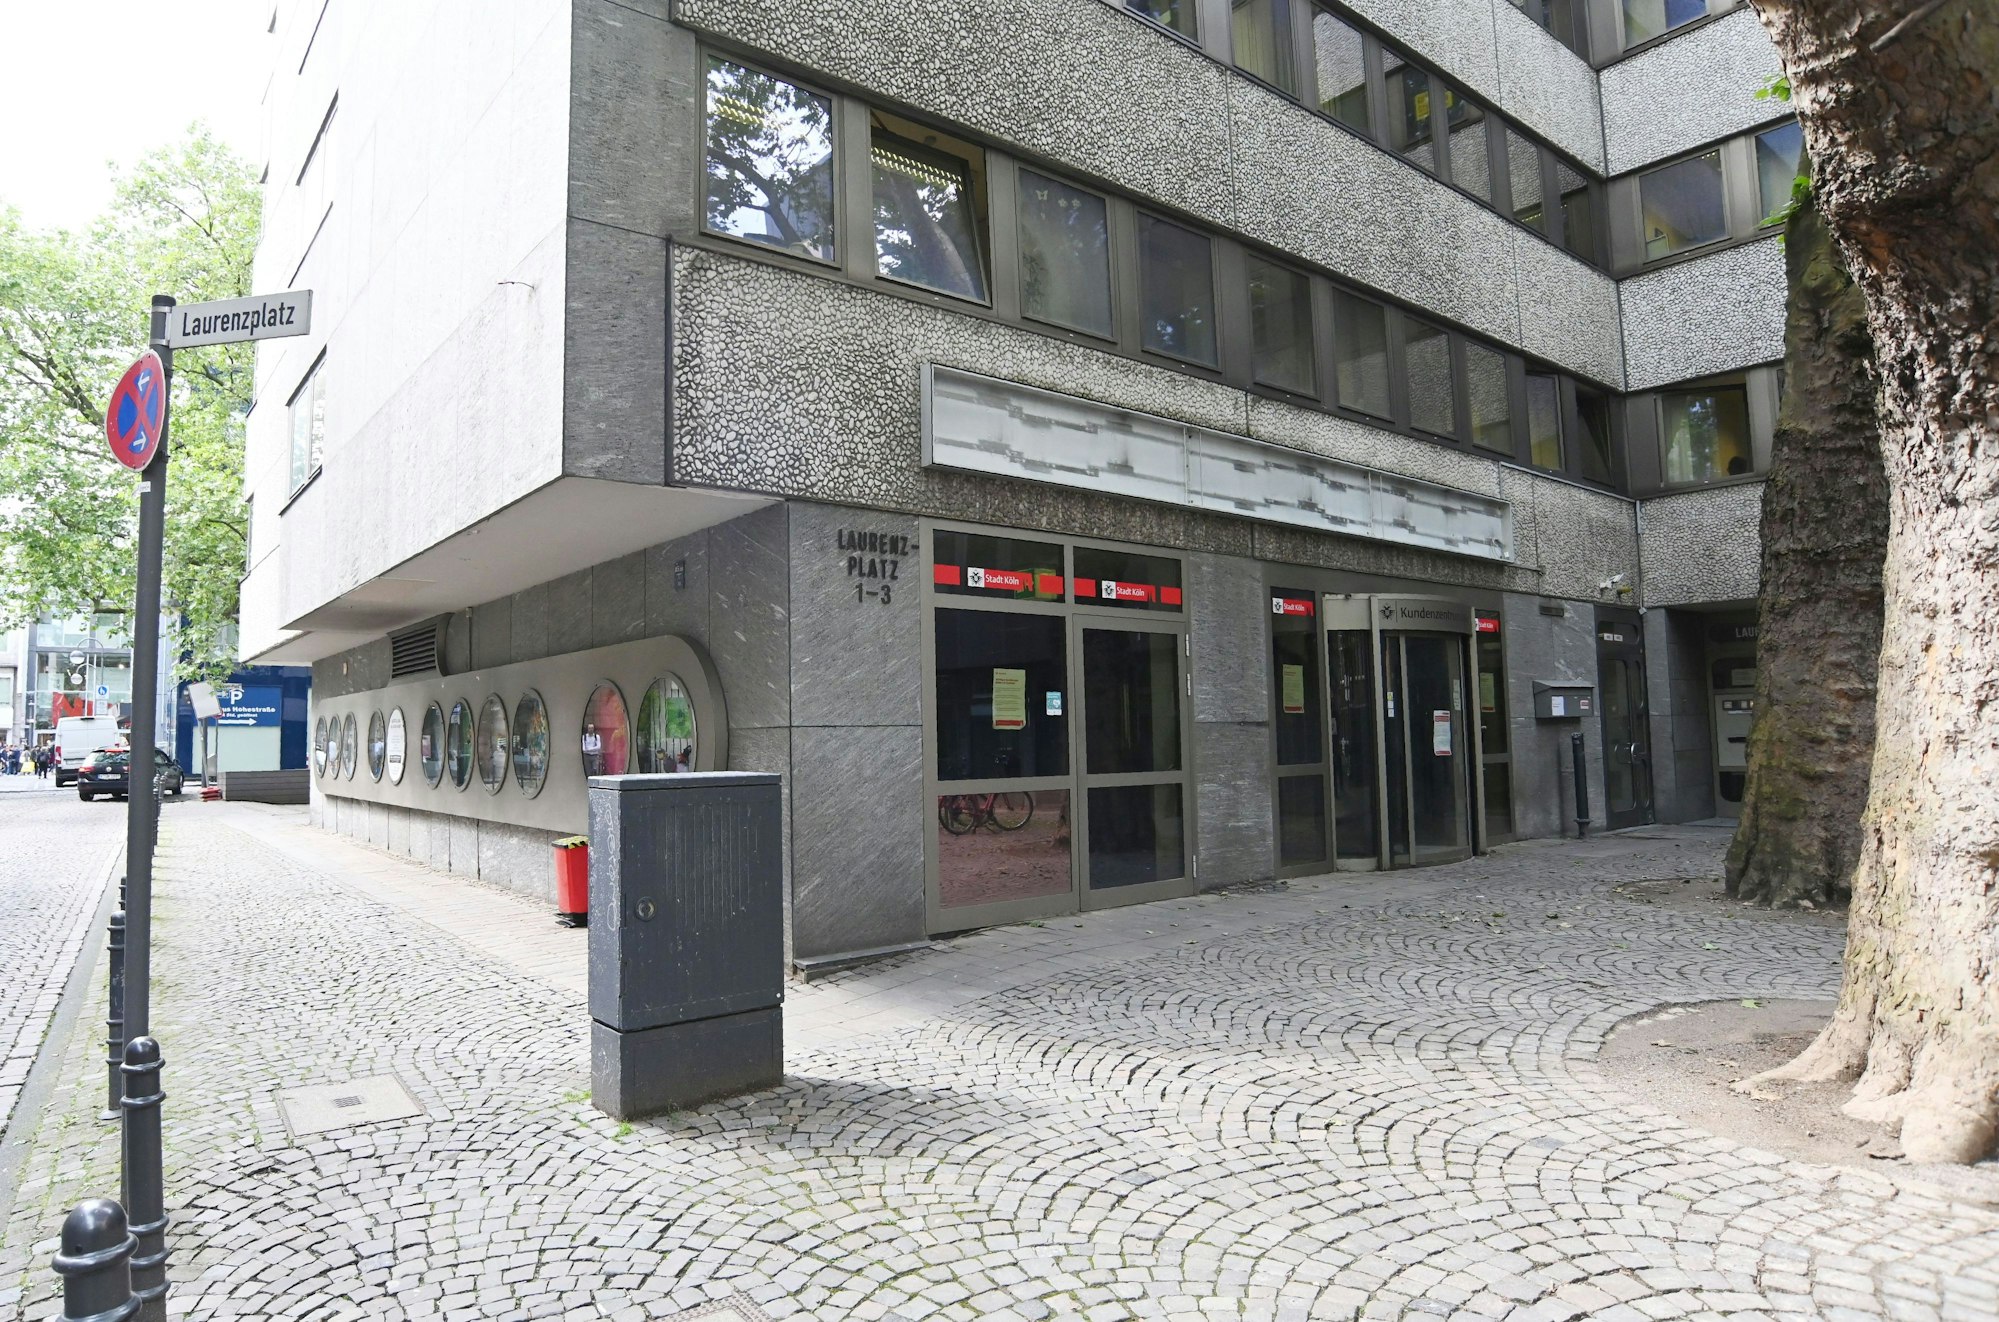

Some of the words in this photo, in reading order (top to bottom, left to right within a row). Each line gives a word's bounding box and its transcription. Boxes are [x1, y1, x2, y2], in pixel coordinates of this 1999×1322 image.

[182, 302, 295, 337] Laurenzplatz
[837, 528, 919, 556] LAURENZ-
[847, 556, 899, 580] PLATZ
[985, 574, 1003, 584] Stadt
[1004, 575, 1019, 585] Köln
[1116, 586, 1131, 596] Stadt
[1132, 587, 1145, 597] Köln
[1283, 602, 1294, 611] Stadt
[1294, 603, 1305, 612] Köln
